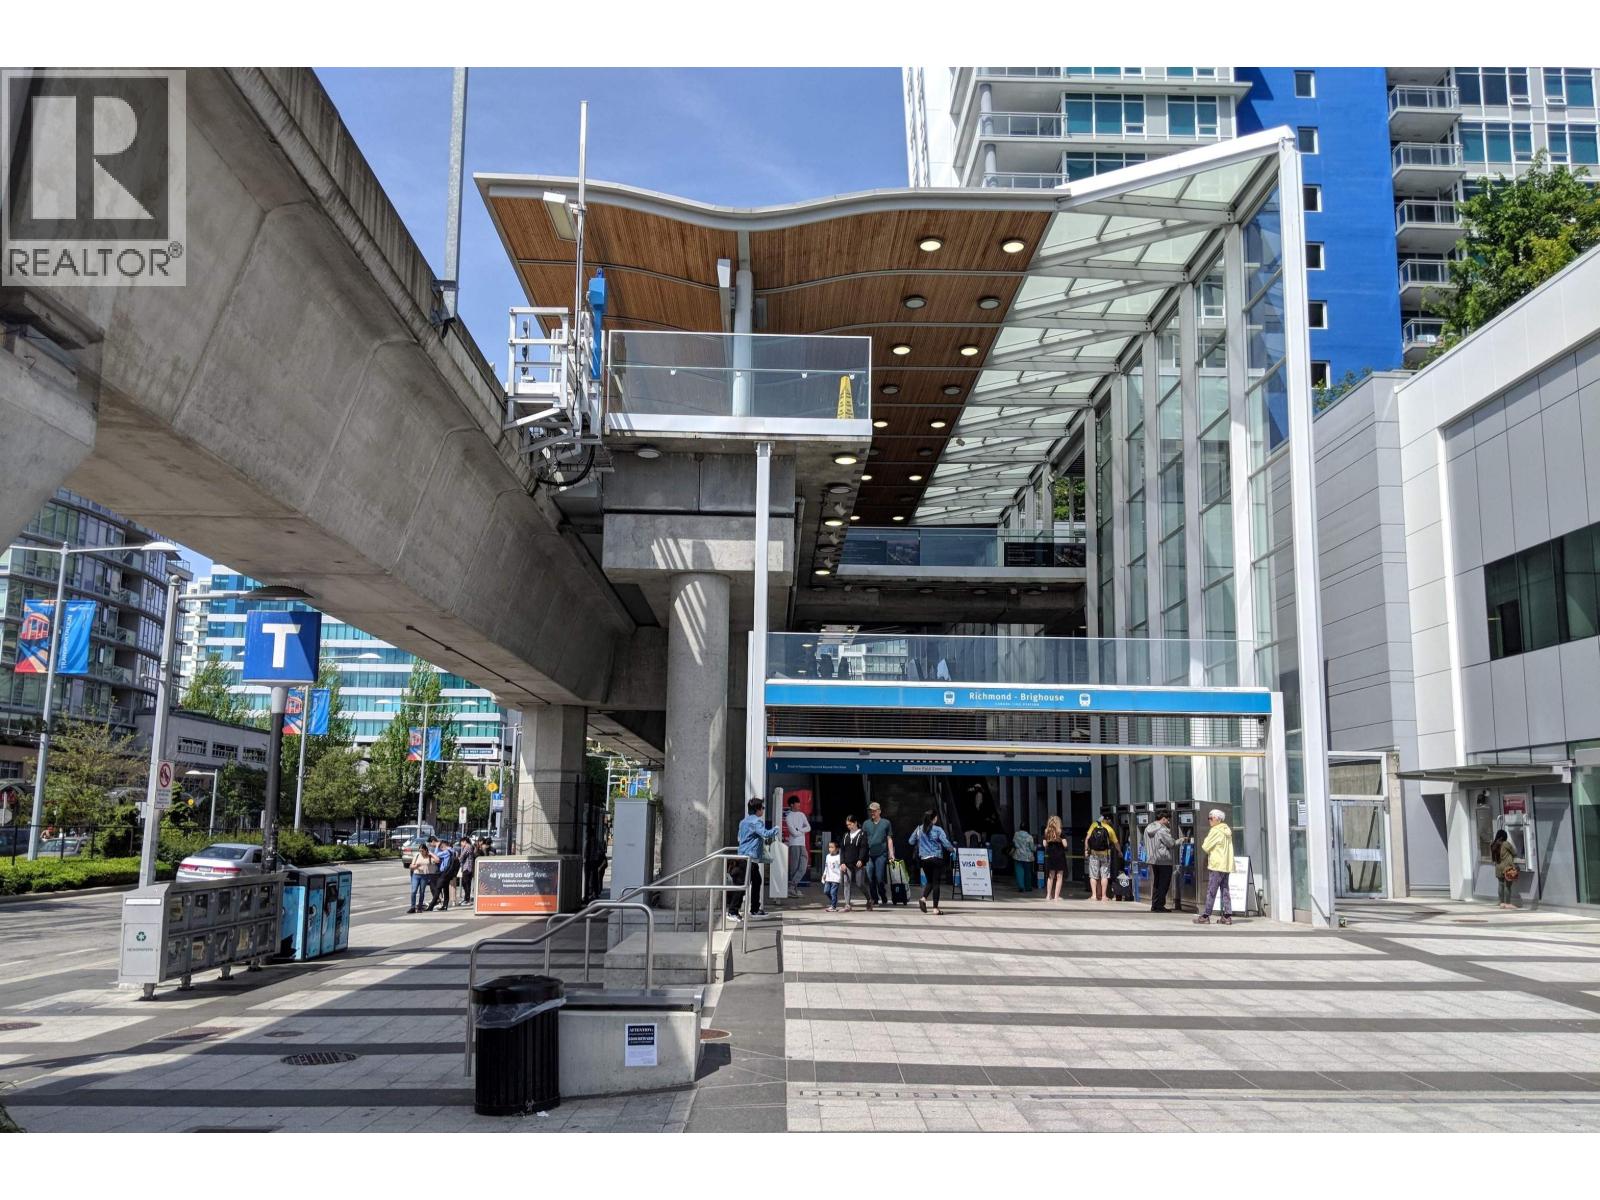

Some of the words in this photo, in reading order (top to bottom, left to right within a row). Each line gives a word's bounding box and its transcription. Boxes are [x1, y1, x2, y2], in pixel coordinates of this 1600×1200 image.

[261, 623, 302, 669] T
[969, 691, 1012, 701] Richmond
[1020, 692, 1065, 703] Brighouse
[962, 860, 976, 868] VISA
[497, 872, 514, 880] years
[535, 871, 548, 879] Ave.
